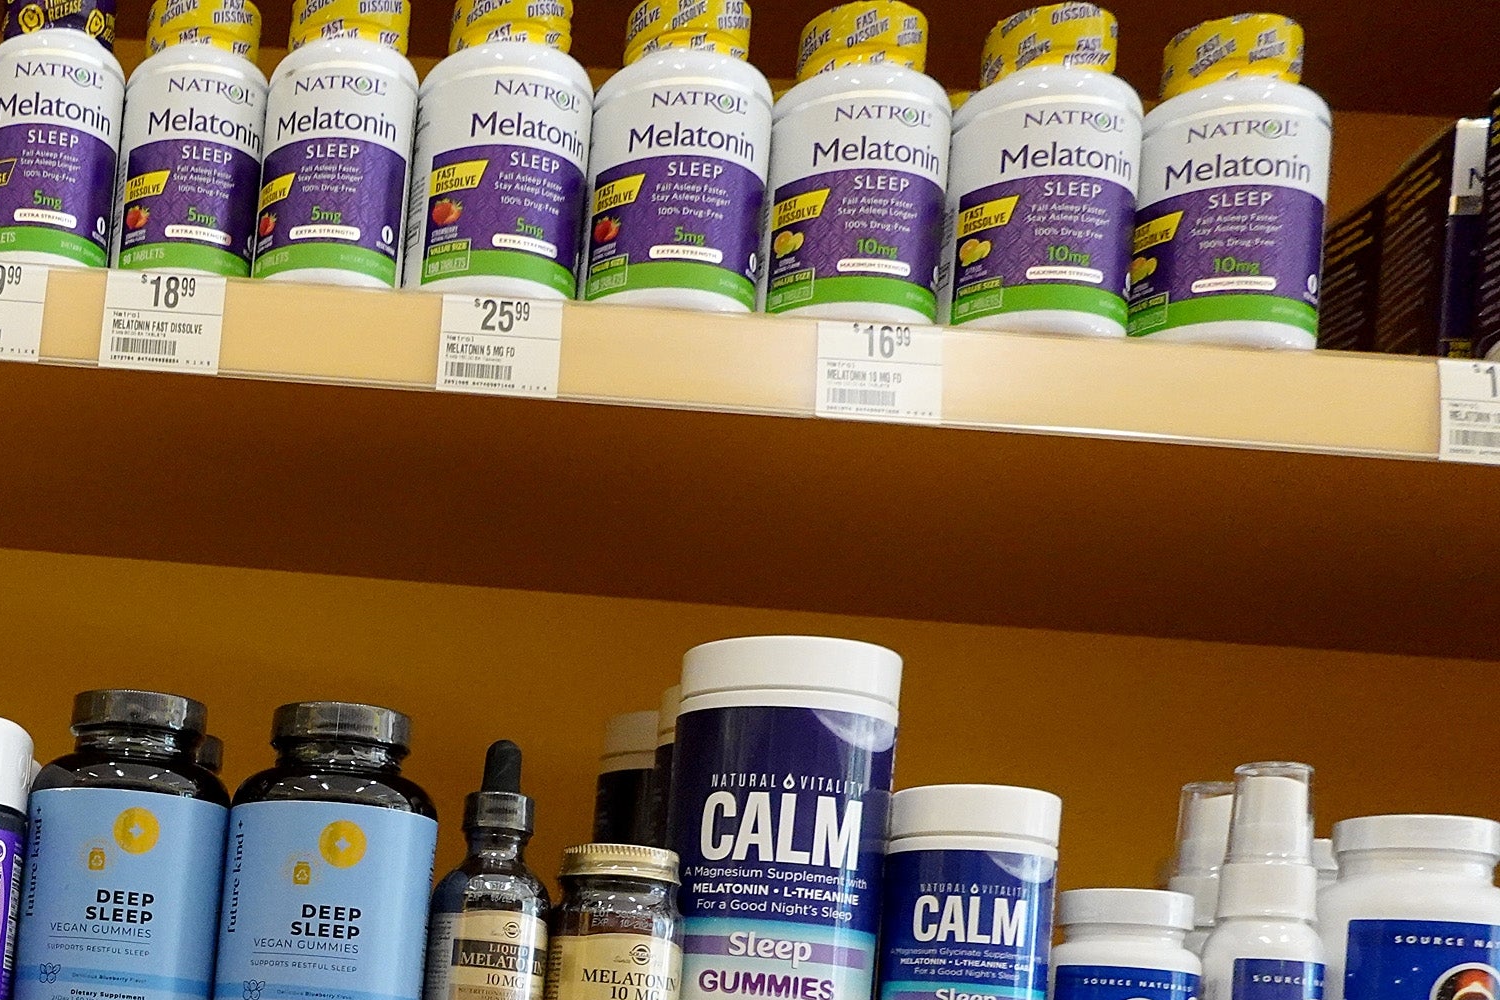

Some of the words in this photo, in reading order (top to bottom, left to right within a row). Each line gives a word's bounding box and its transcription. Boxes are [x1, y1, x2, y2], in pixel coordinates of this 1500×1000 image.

[15, 61, 100, 88] NATROL
[168, 77, 253, 106] NATROL
[494, 79, 578, 112] NATROL
[835, 105, 930, 127] NATROL
[27, 130, 79, 148] SLEEP
[148, 108, 260, 153] Melatonin
[470, 111, 584, 162] Melatonin
[1187, 120, 1298, 144] NATROL
[182, 145, 232, 165] SLEEP
[510, 151, 560, 174] SLEEP
[812, 135, 940, 174] Melatonin
[436, 166, 455, 180] FAST
[436, 173, 476, 191] DISSOLVE
[854, 175, 909, 192] SLEEP
[1164, 154, 1311, 191] Melatonin
[33, 190, 62, 210] 5mg
[1208, 191, 1272, 208] SLEEP
[857, 238, 897, 258] 10mg
[113, 319, 149, 333] MELATONIN
[152, 322, 168, 333] FAST
[171, 323, 202, 335] DISSOLVE
[712, 773, 776, 788] NATURAL
[801, 775, 863, 795] VITALITY
[700, 791, 863, 871] CALM
[692, 882, 769, 896] MELATONIN
[783, 887, 859, 905] L-THEANINE
[301, 904, 362, 921] DEEP
[913, 894, 1027, 947] CALM
[290, 921, 360, 939] SLEEP
[254, 938, 293, 950] VEGAN
[297, 939, 358, 954] GUMMIES
[728, 931, 812, 963] Sleep
[581, 968, 678, 991] MELATONIN
[611, 985, 628, 999] 10
